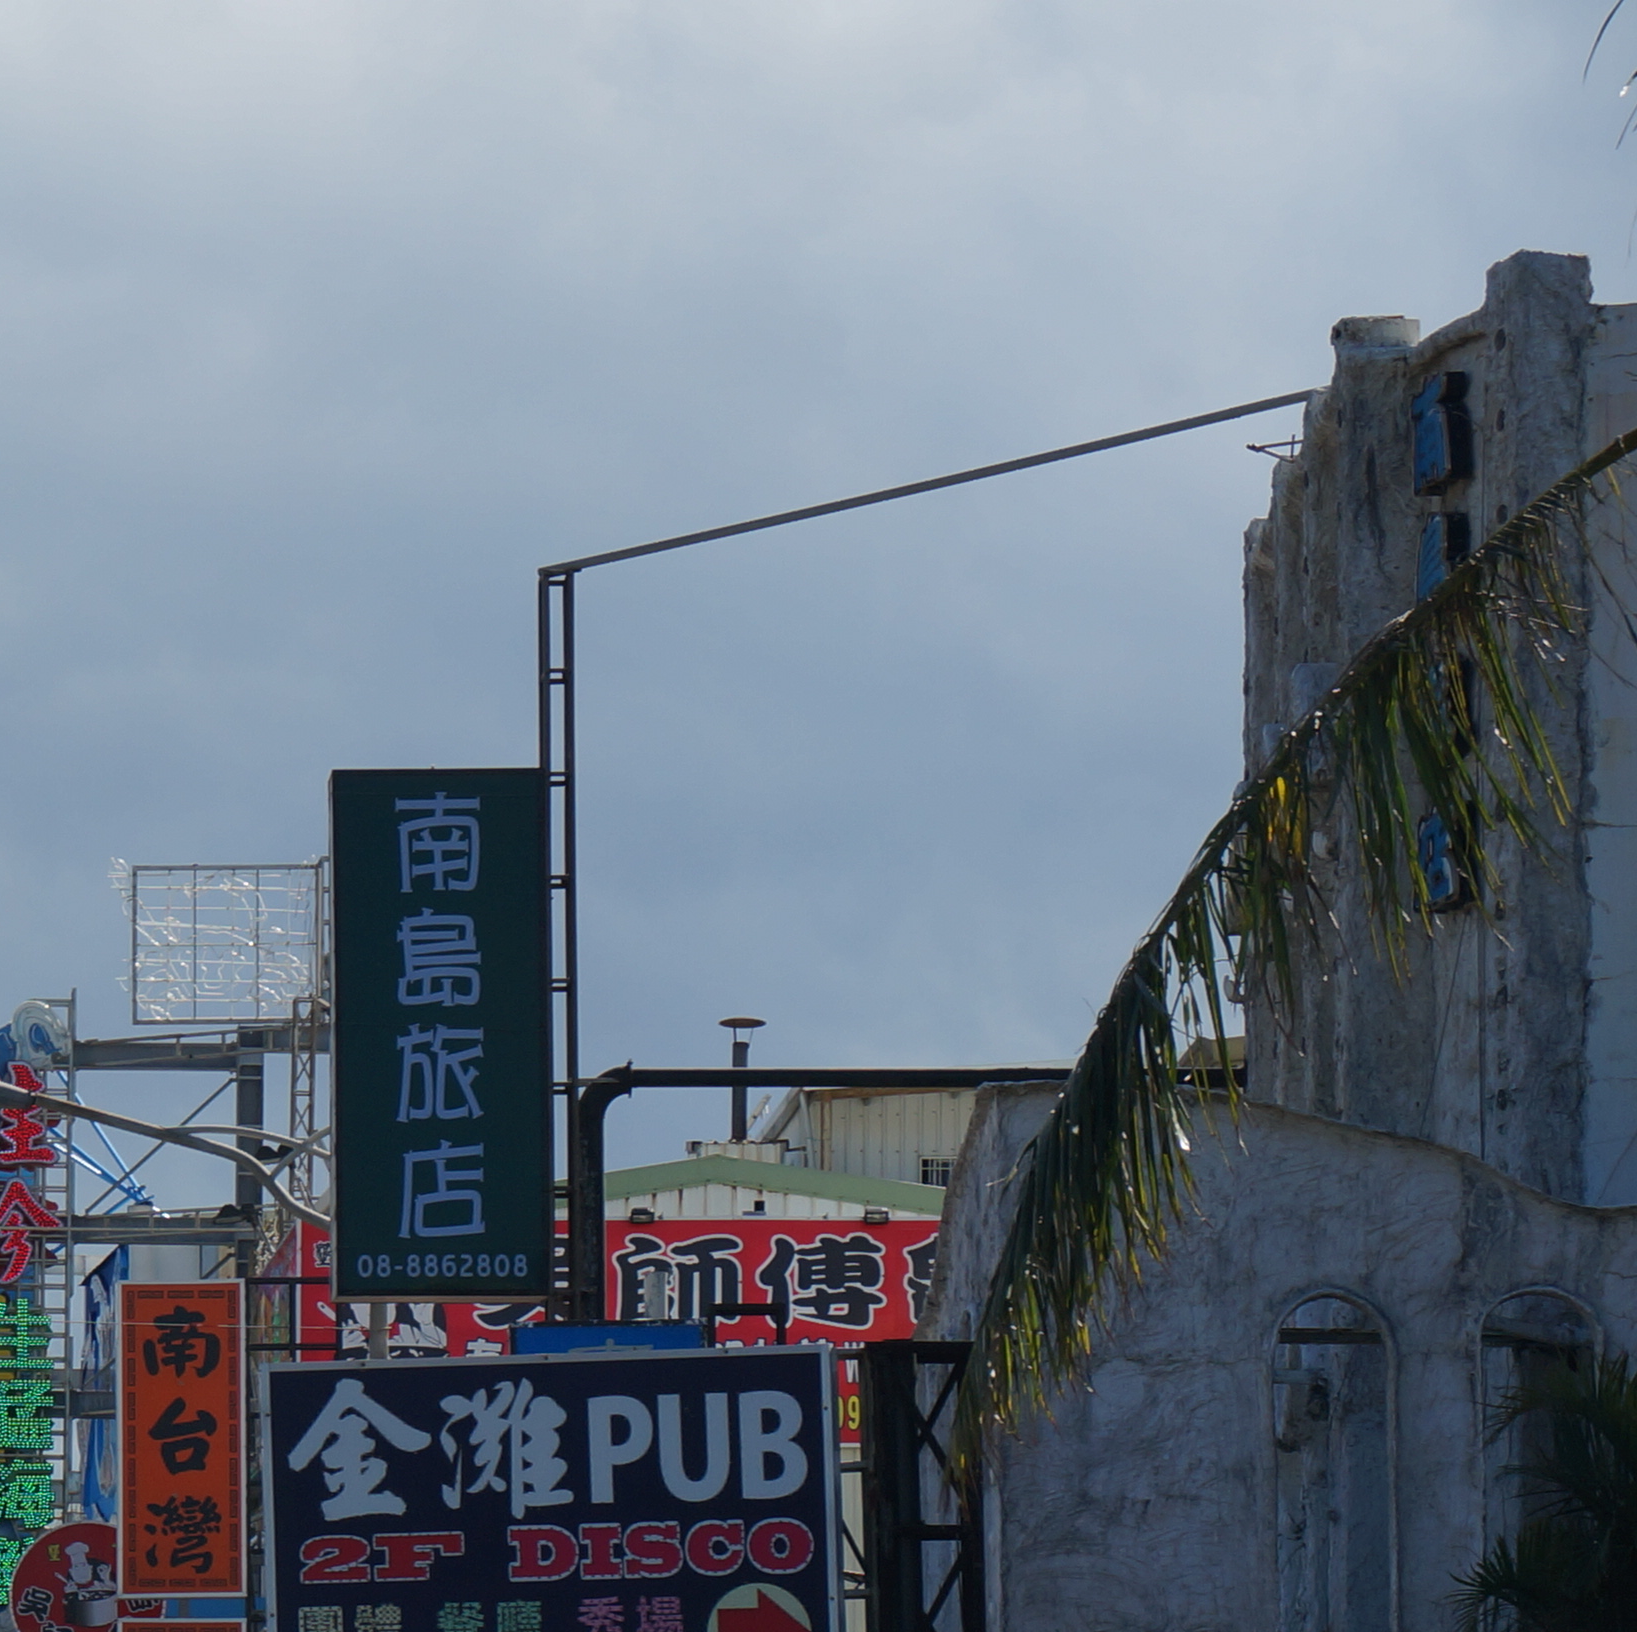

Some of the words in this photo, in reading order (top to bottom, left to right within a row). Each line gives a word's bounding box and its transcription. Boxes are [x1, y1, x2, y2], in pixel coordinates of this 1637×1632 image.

[395, 792, 485, 1238] 南島旅店
[357, 1253, 528, 1279] 08-8862808
[143, 1306, 221, 1575] 南台灣
[287, 1378, 575, 1521] 金灘
[586, 1390, 808, 1504] PUB
[299, 1531, 465, 1585] 2F
[507, 1518, 814, 1582] DISCO
